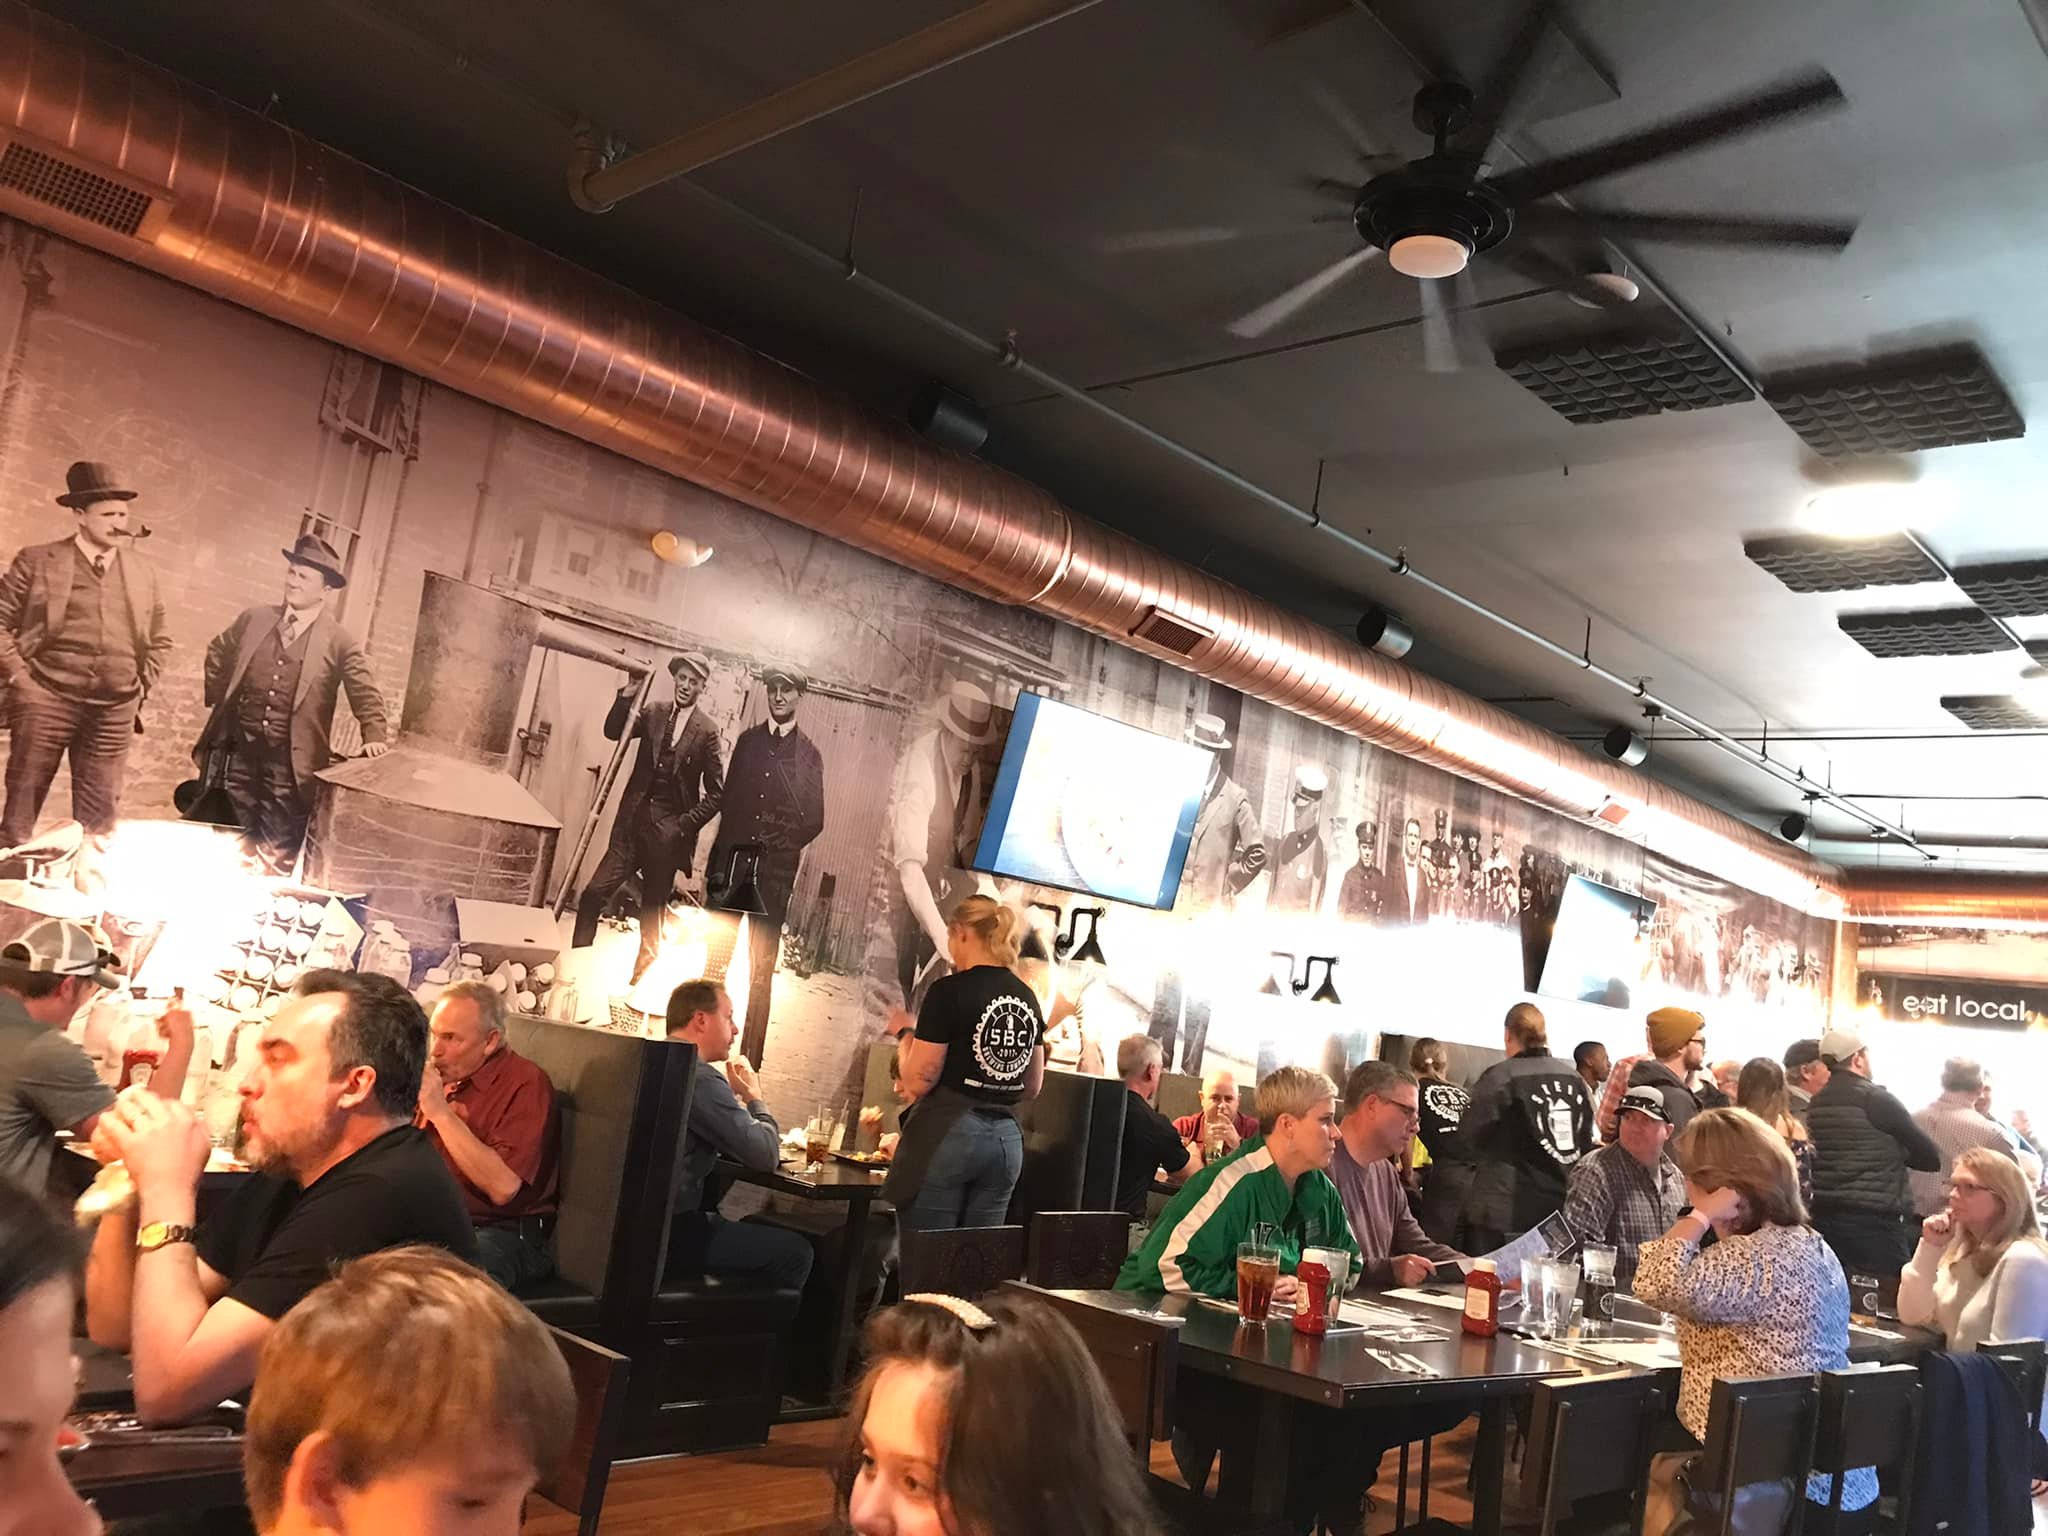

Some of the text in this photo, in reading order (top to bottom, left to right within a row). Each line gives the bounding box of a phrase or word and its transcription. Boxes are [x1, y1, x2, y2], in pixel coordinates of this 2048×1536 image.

[1902, 993, 2026, 1022] eat local
[990, 1028, 1028, 1047] SBC
